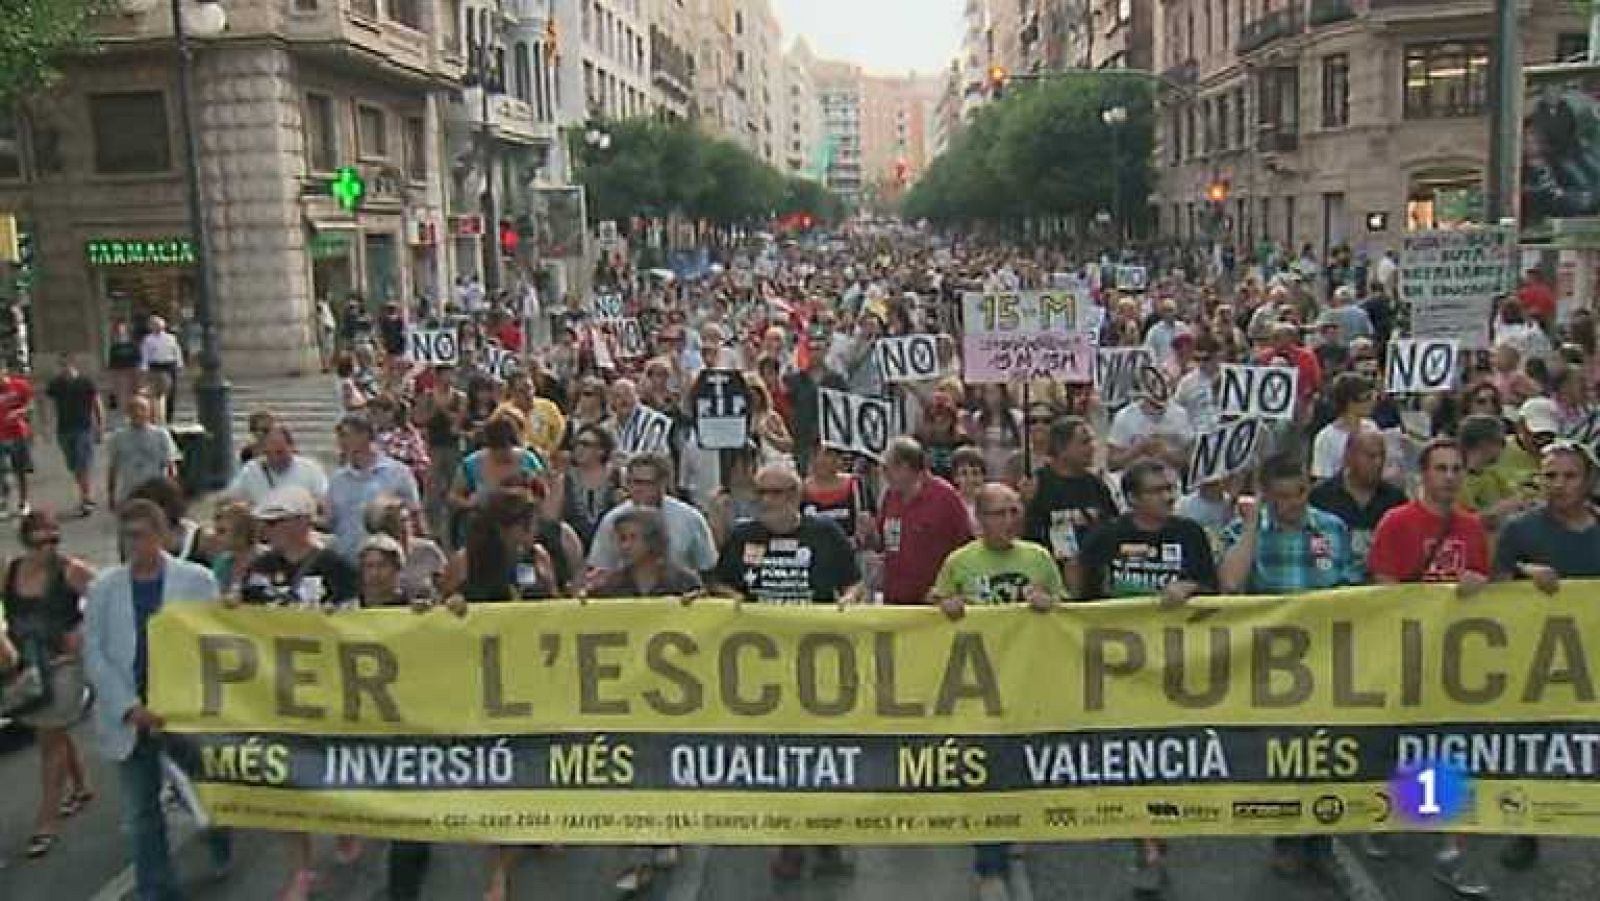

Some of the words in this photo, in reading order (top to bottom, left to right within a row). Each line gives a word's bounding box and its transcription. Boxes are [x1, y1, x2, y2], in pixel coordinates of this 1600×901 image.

[412, 332, 455, 361] NO
[881, 337, 935, 377] NO
[1389, 343, 1452, 387] NO
[1221, 367, 1293, 413] NO
[822, 391, 888, 453] NO
[1192, 418, 1257, 479] NO
[199, 633, 402, 723] PER
[479, 629, 1005, 719] L'ESCOLA
[1082, 609, 1599, 712] PÚBLICA
[200, 738, 289, 785] MÉS
[324, 739, 514, 784] INVERSIÓ
[549, 736, 634, 785] MÉS
[671, 744, 862, 787] QUALITAT
[900, 738, 988, 787] MÉS
[1024, 729, 1229, 783] VALENCIÀ
[1266, 730, 1360, 777] MÉS
[1399, 733, 1600, 778] DIGNITAT
